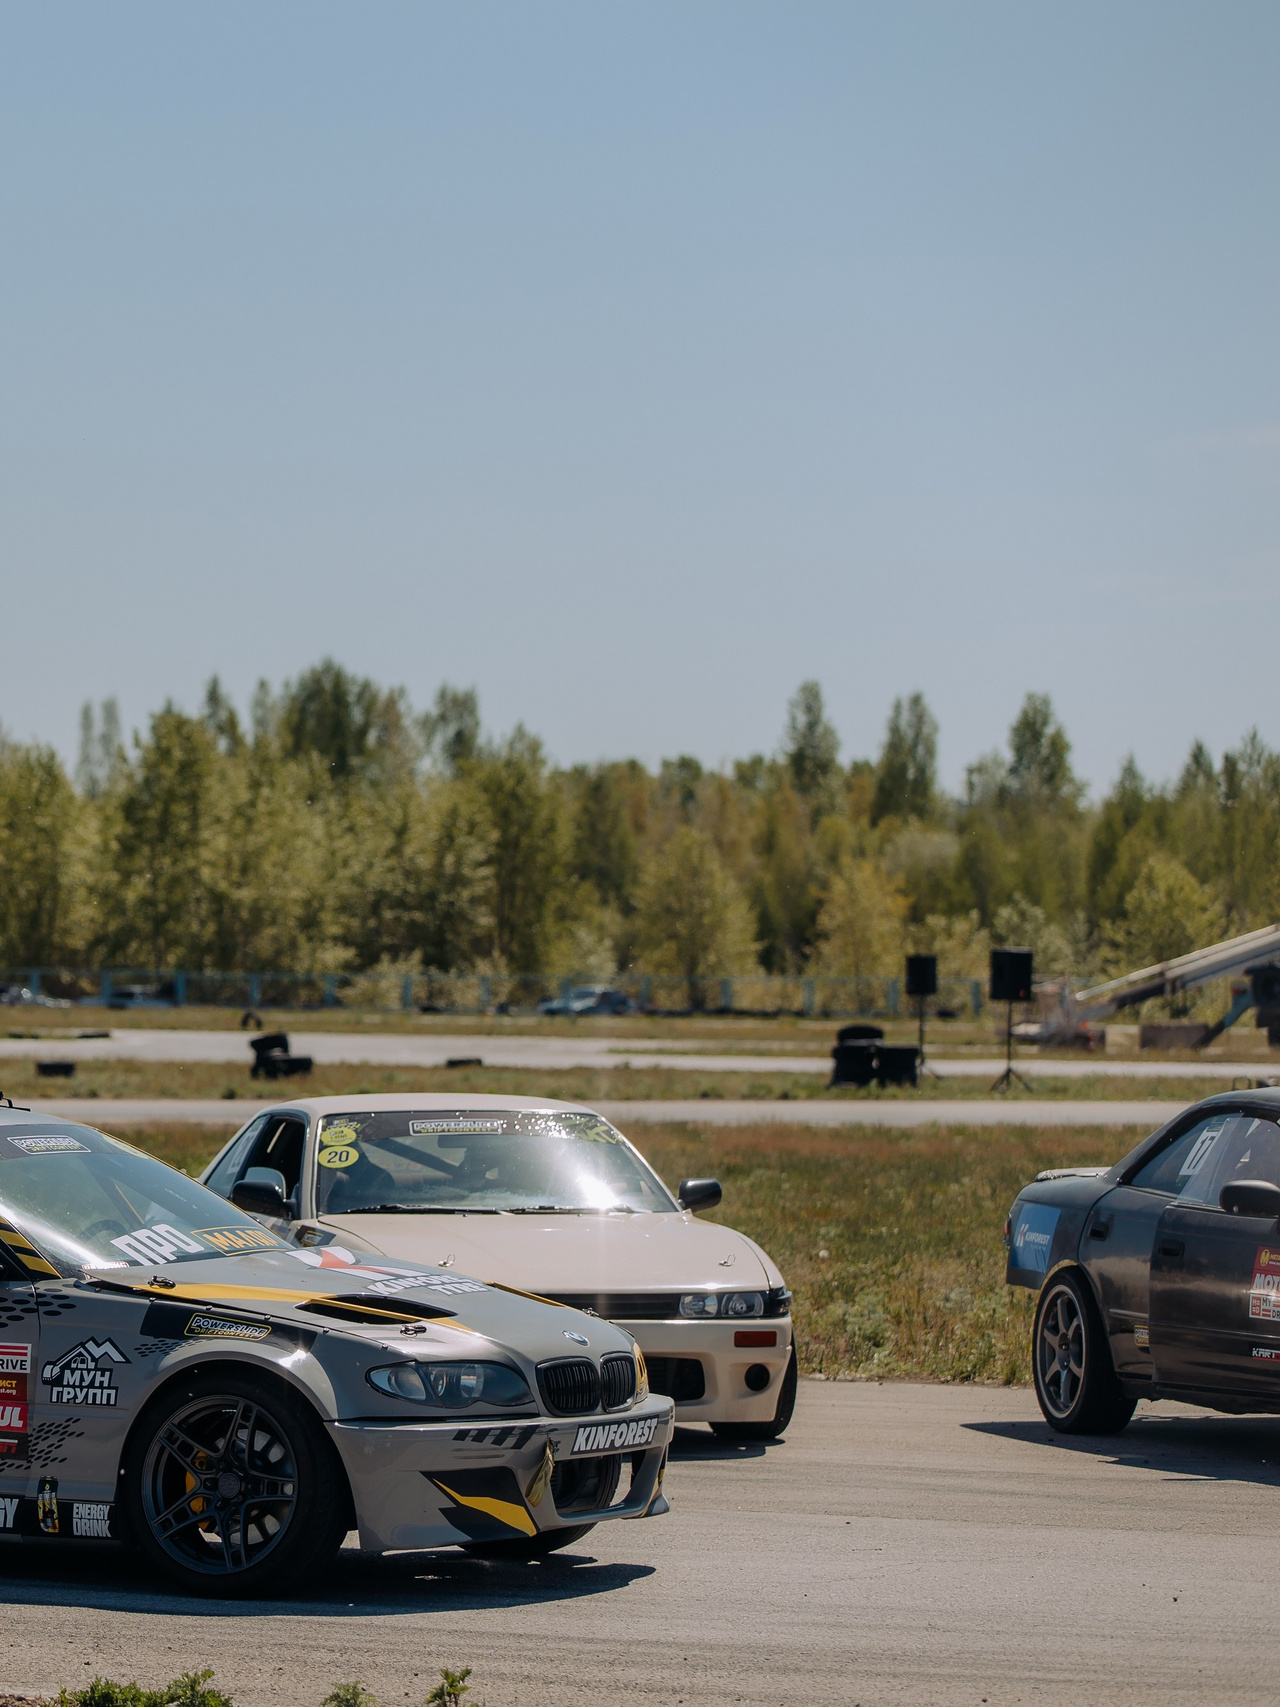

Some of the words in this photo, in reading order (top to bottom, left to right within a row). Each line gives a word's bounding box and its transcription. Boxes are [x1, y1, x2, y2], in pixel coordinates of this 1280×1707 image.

[327, 1150, 350, 1163] 20
[1187, 1135, 1217, 1170] 17
[110, 1223, 205, 1267] ПРО
[1253, 1272, 1280, 1293] MOT
[192, 1316, 268, 1336] POWERSLIDE
[63, 1369, 111, 1387] МУН
[52, 1386, 116, 1405] ГРУПП
[573, 1417, 659, 1452] KINFOREST
[72, 1502, 110, 1520] ENERGY
[72, 1518, 112, 1538] DRINK
